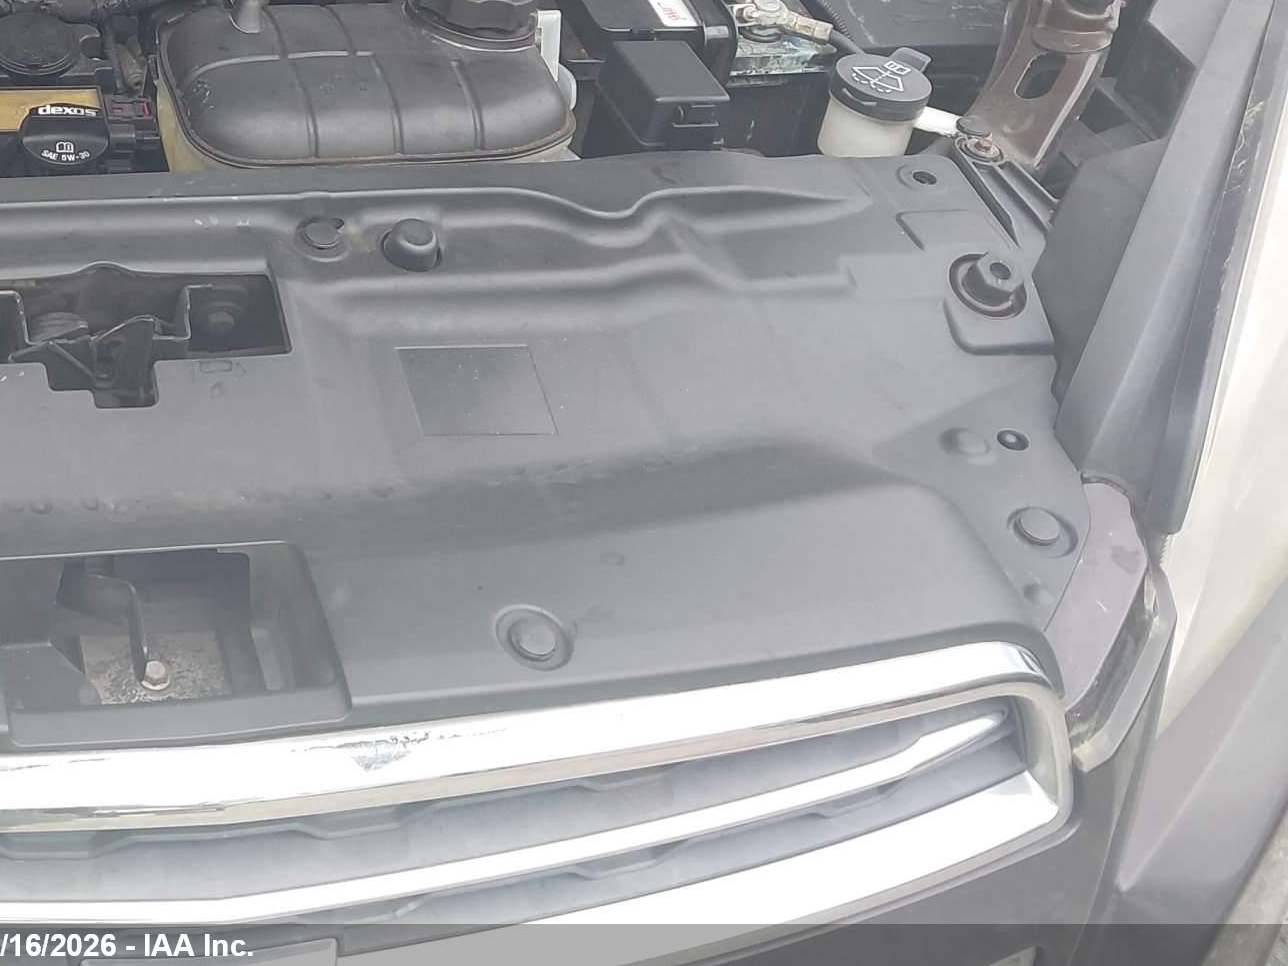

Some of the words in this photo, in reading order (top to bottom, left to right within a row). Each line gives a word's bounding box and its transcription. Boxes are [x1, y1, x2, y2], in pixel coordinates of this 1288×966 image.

[38, 104, 97, 117] dexos
[41, 149, 59, 161] SAE
[61, 151, 90, 161] 5W-30
